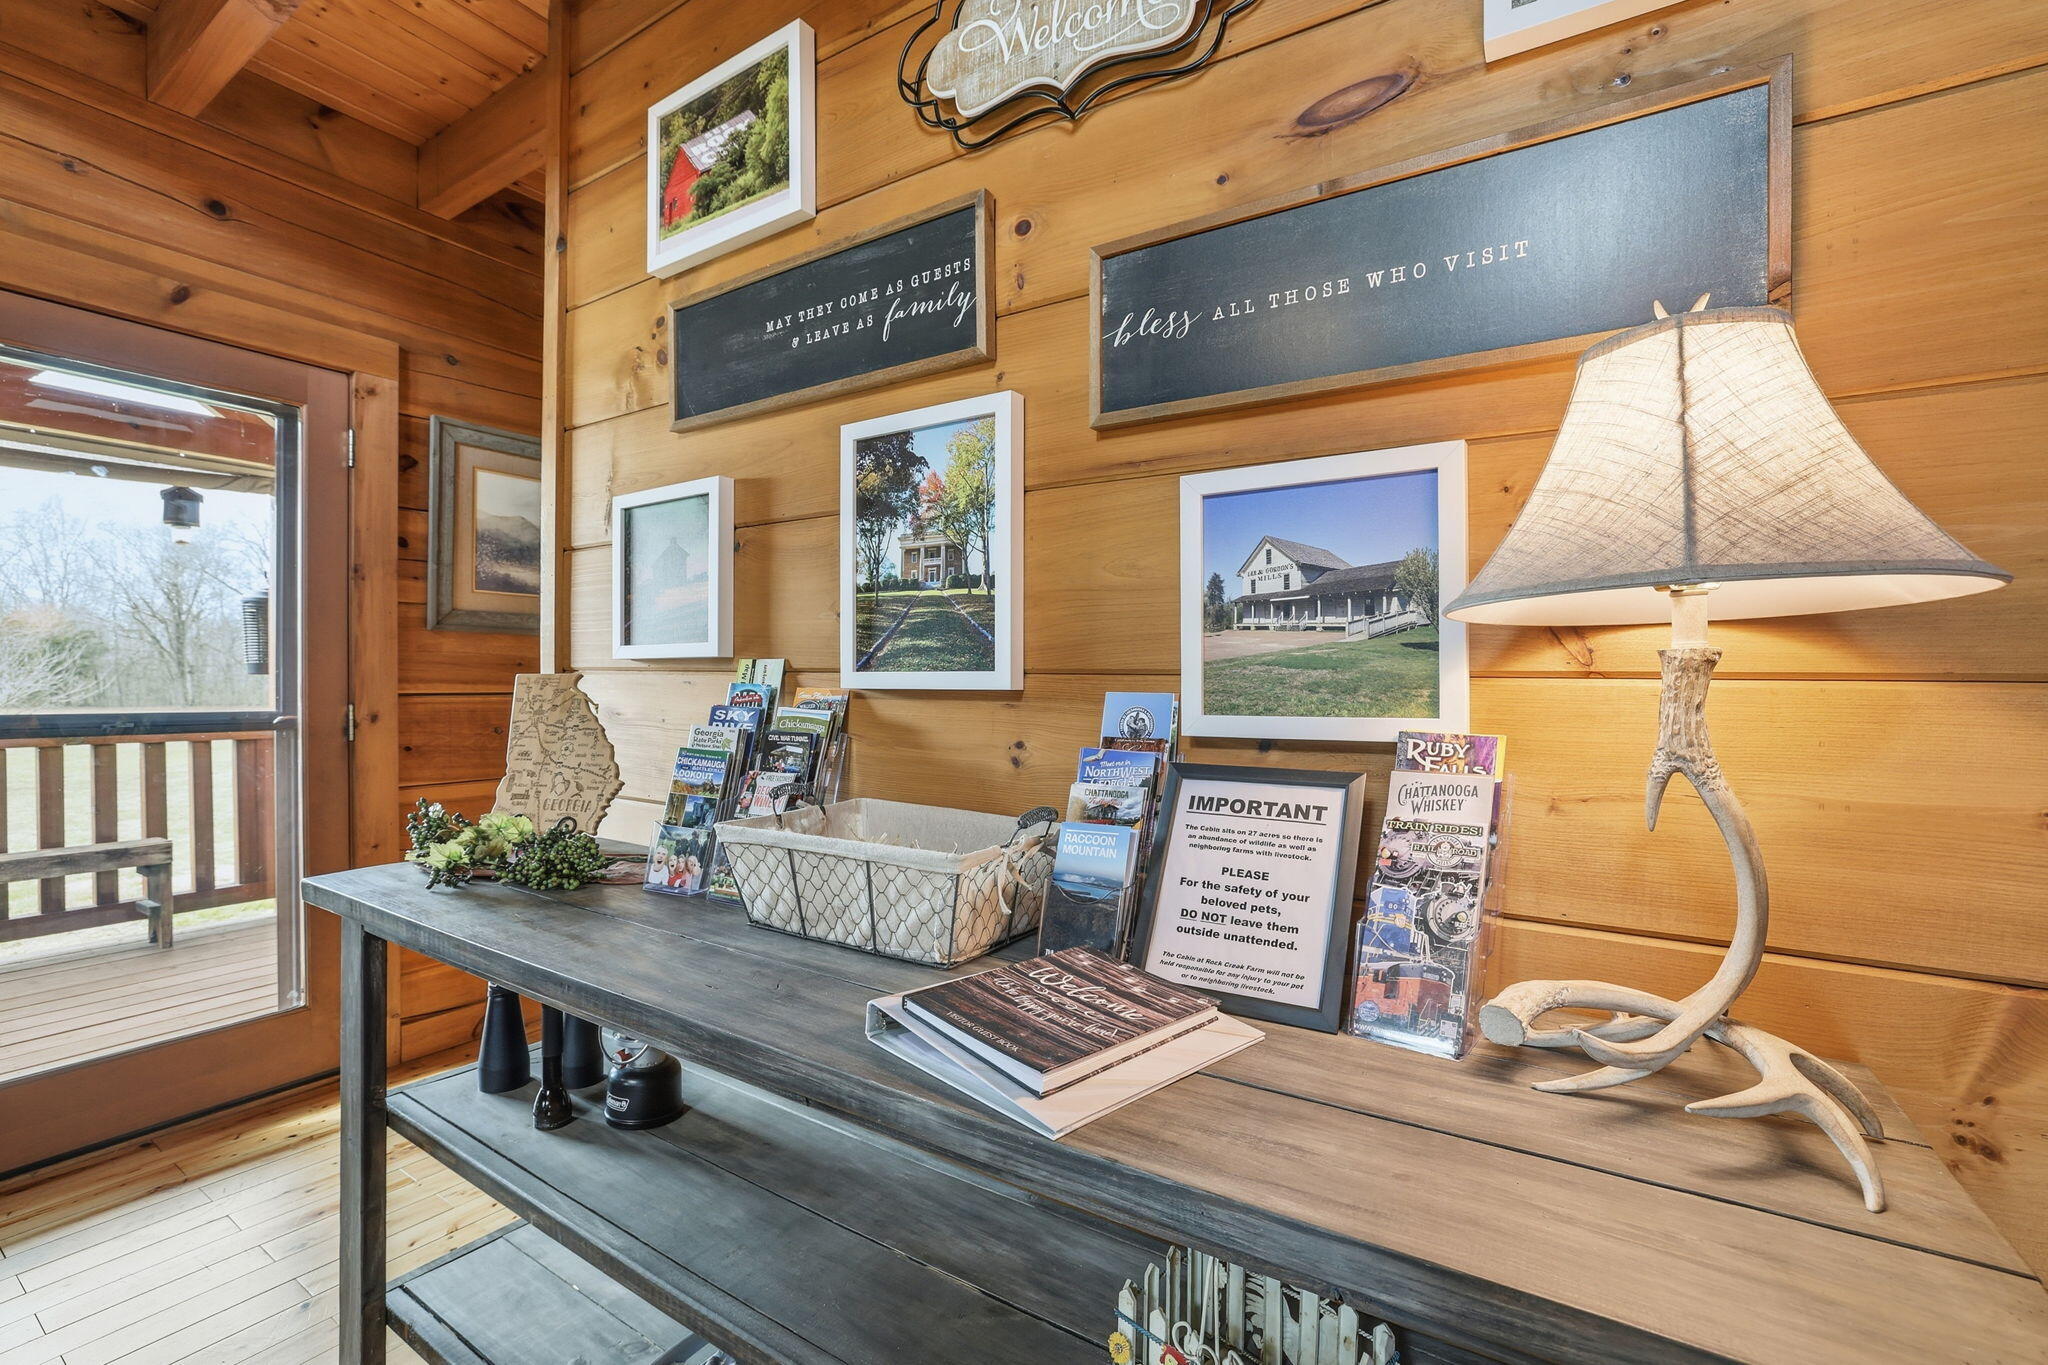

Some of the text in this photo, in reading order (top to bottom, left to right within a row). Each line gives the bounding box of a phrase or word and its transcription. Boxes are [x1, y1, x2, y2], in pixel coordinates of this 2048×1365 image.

[958, 0, 1180, 64] Welcom
[766, 258, 971, 332] MAY THEY COME AS GUESTS
[1103, 240, 1530, 347] bless ALL THOSE WHO VISIT
[806, 323, 849, 344] LEAVE
[856, 315, 874, 330] AS
[882, 280, 977, 342] family
[713, 709, 756, 721] SKY
[694, 727, 724, 740] Georgia
[779, 718, 826, 734] Chickamauga
[1406, 738, 1470, 767] RUBY
[677, 756, 727, 769] CHICKAMAUGA
[674, 769, 714, 780] LOOKOUT
[754, 794, 785, 808] WINEY
[1084, 788, 1129, 799] CHATTANOOGA
[1398, 781, 1479, 806] CHATTANOOGA
[1188, 795, 1328, 821] IMPORTANT
[1411, 796, 1465, 815] WHISKEY
[1200, 825, 1220, 833] Cabin
[1293, 834, 1314, 842] there
[1315, 836, 1323, 844] is
[1386, 820, 1483, 837] TRAIN RIDES!
[1064, 832, 1116, 846] RACCOON
[1198, 834, 1237, 844] abundance
[1249, 839, 1276, 848] wildlife
[1062, 844, 1117, 858] MOUNTAIN
[1189, 842, 1312, 861] neighboring farms with livestock.
[1413, 843, 1478, 857] RAIL ROAD
[1221, 867, 1270, 881] PLEASE
[1179, 876, 1310, 903] For the safety of your
[1200, 895, 1282, 917] beloved pets,
[1180, 908, 1299, 934] DO NOT leave them
[1176, 925, 1298, 951] outside unattended.
[1159, 959, 1175, 967] held
[1175, 962, 1215, 974] responsible
[1241, 974, 1263, 983] injury
[1272, 980, 1289, 988] your
[1176, 953, 1196, 962] Cabin
[1205, 958, 1223, 967] Rock
[1224, 961, 1245, 970] Creek
[1245, 965, 1265, 974] Farm
[1281, 971, 1294, 979] not
[1029, 967, 1147, 1020] Welcome
[1199, 976, 1239, 989] neighboring
[1240, 983, 1275, 995] livestock.
[972, 1026, 1000, 1040] GUEST
